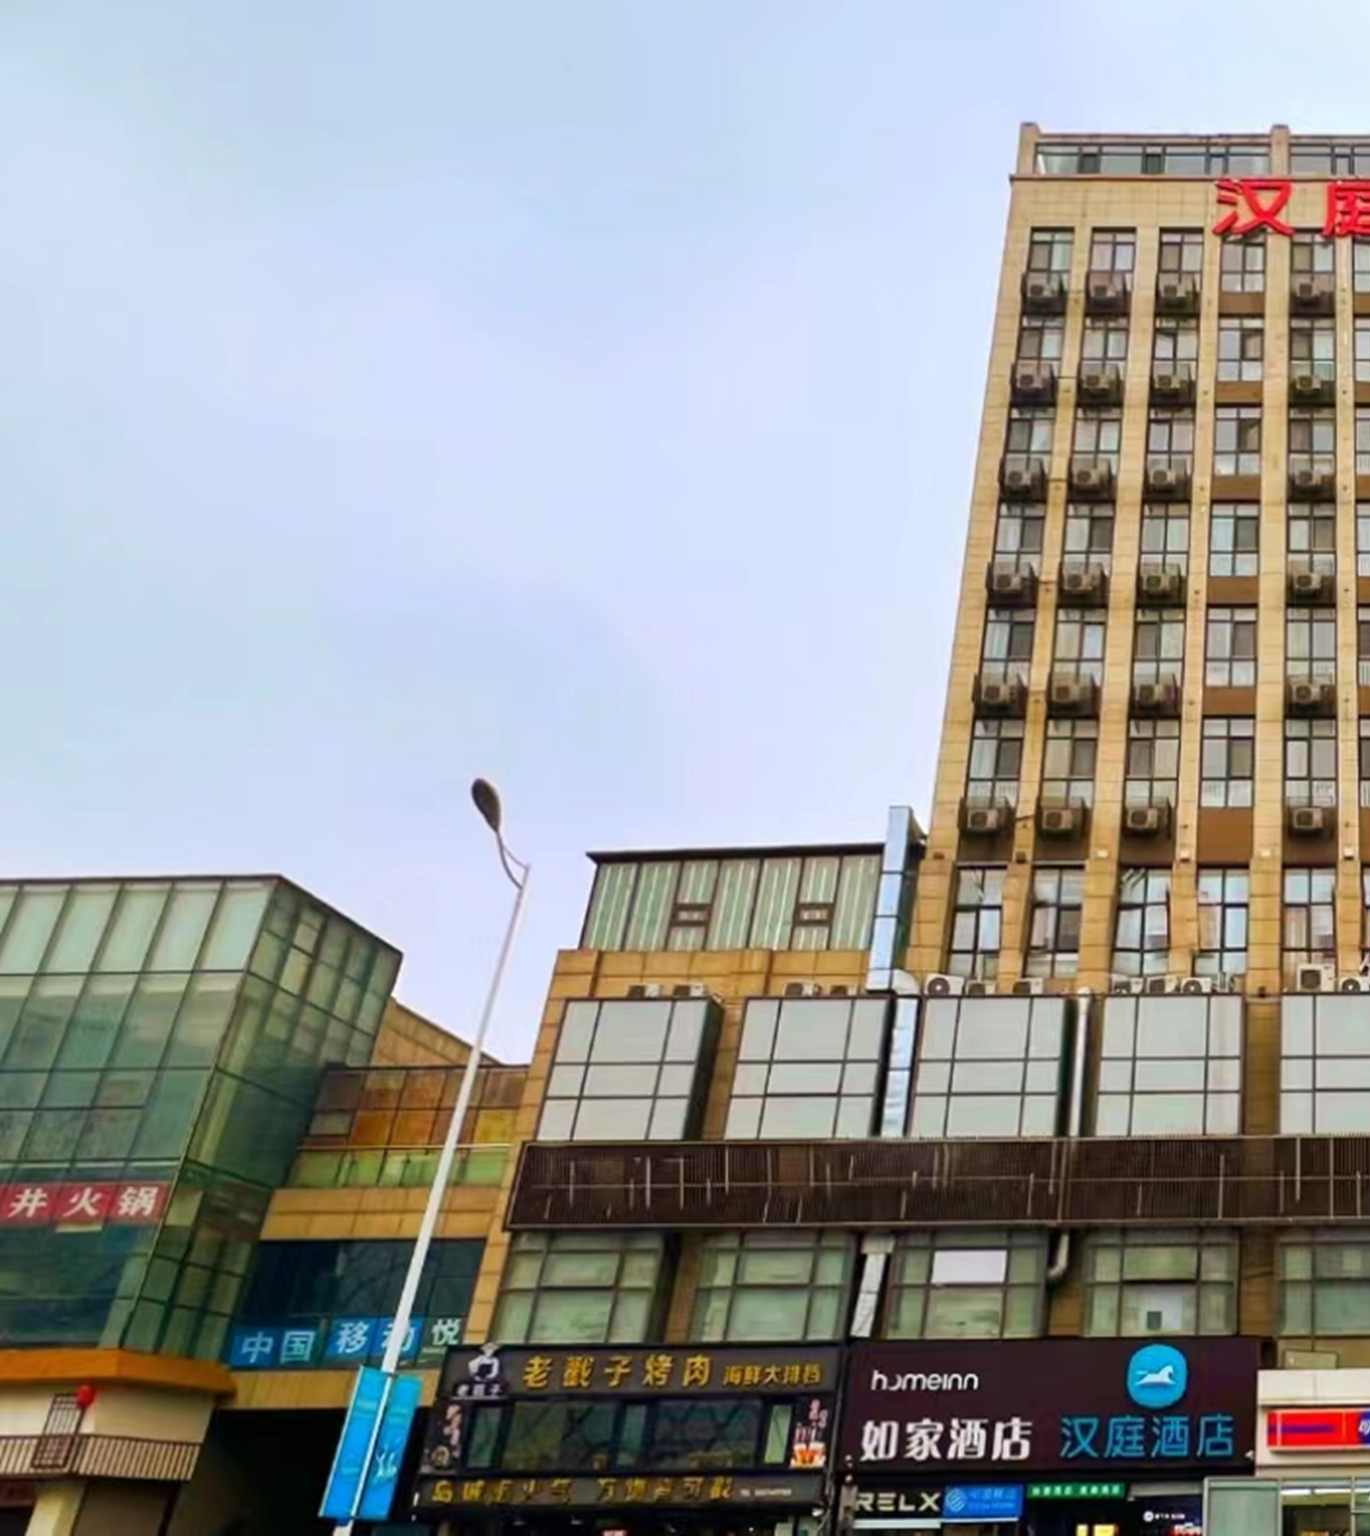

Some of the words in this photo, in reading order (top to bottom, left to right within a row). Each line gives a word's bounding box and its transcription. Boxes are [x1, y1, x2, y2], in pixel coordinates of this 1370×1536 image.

[8, 1186, 159, 1219] 井火锅
[860, 1416, 1034, 1461] 如家酒店
[1060, 1413, 1235, 1459] 汉庭酒店
[856, 1492, 942, 1512] RELX
